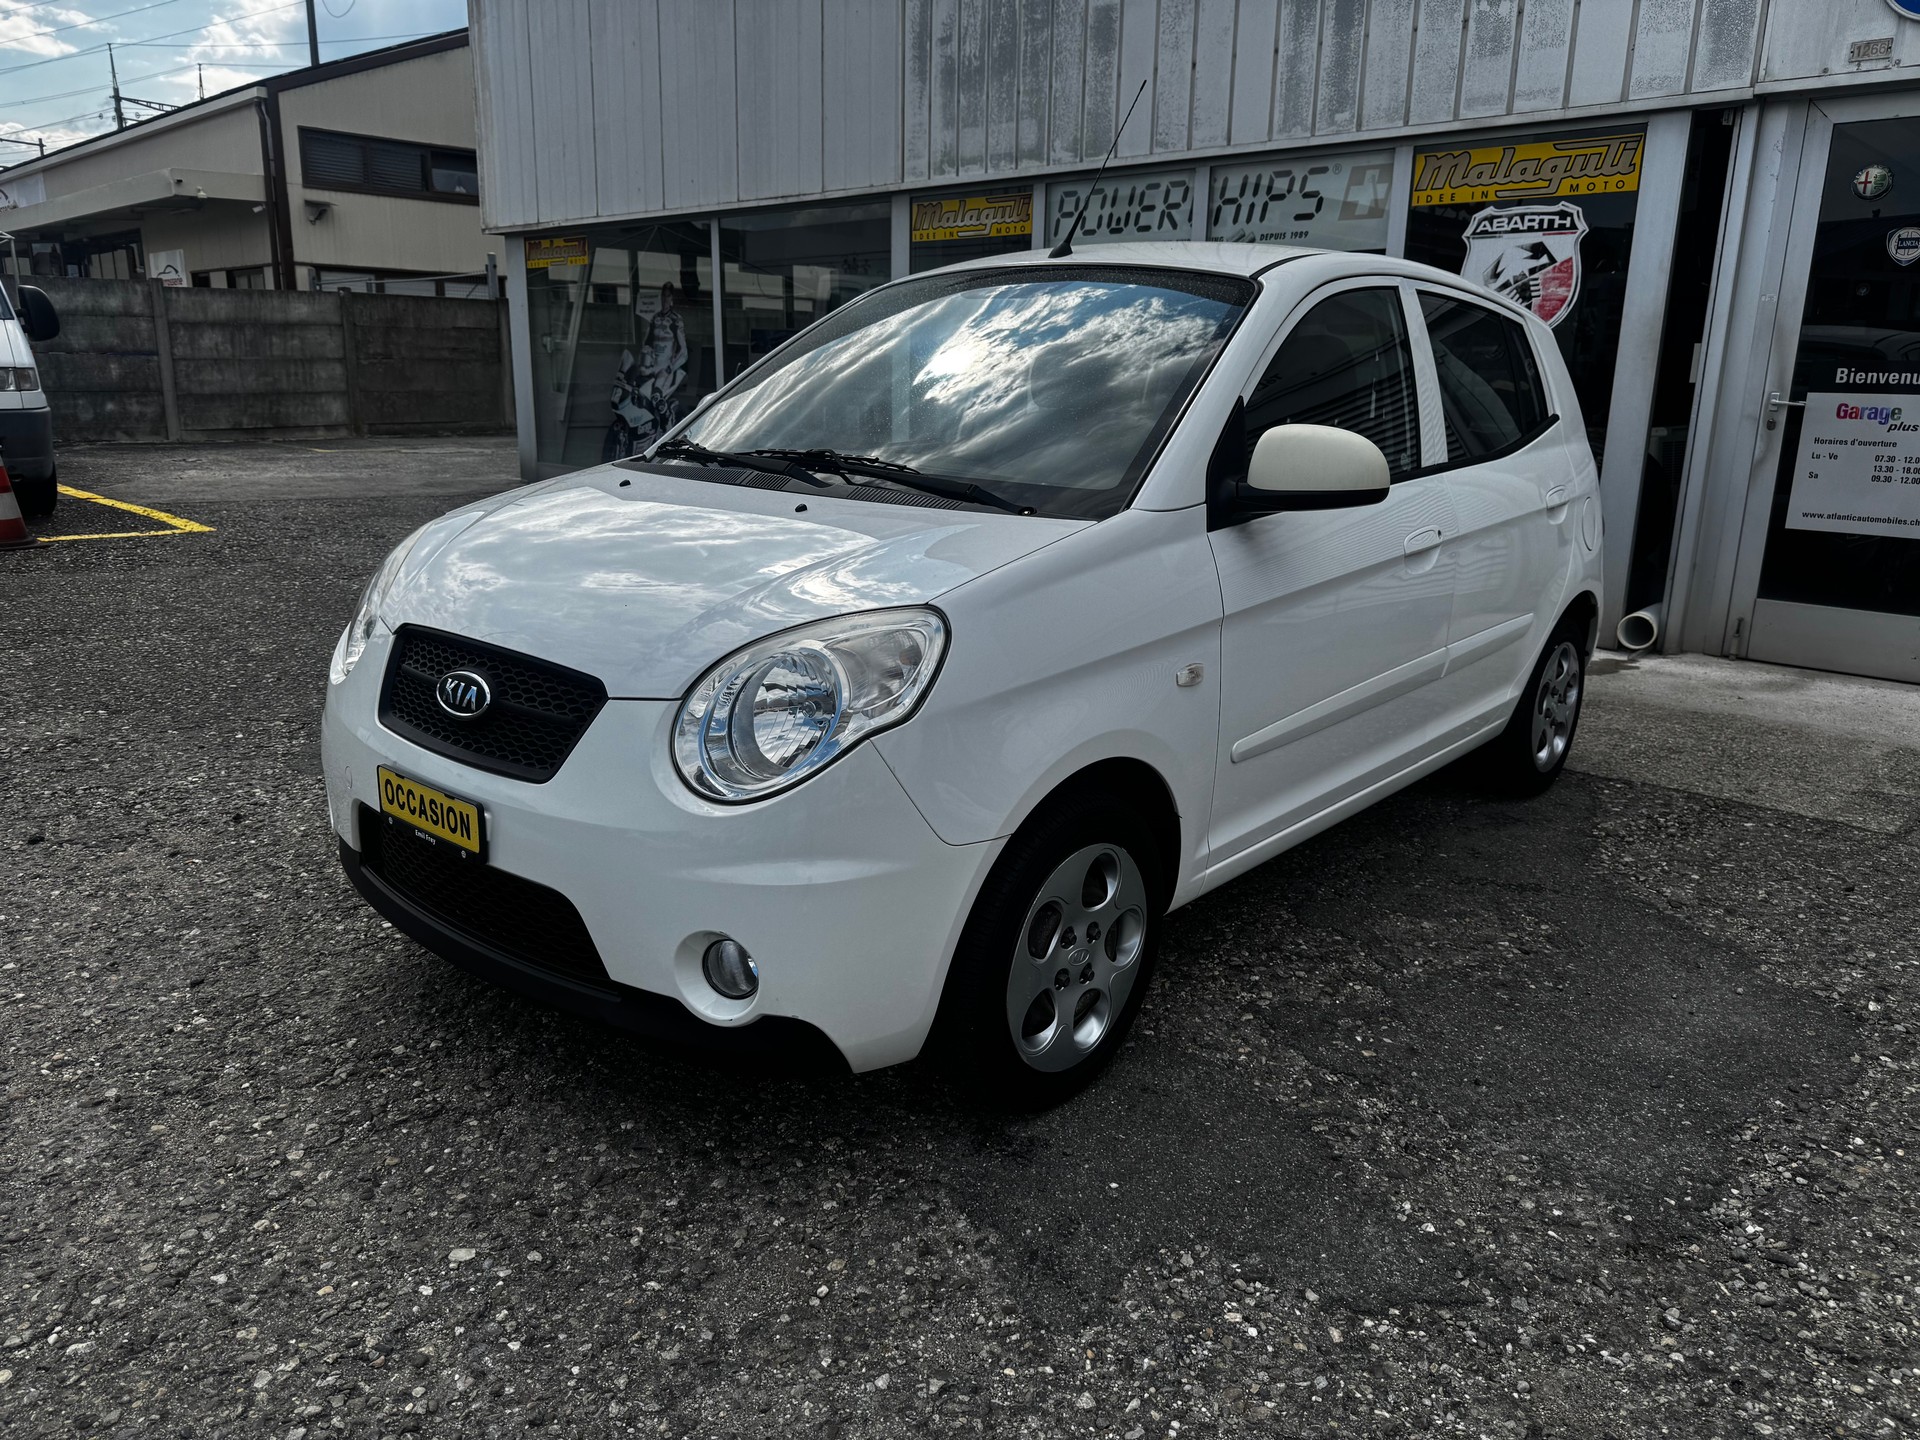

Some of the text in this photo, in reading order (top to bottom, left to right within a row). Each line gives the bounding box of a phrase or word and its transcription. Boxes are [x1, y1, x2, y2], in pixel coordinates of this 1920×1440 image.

[1855, 42, 1887, 58] 1266
[1414, 135, 1644, 199] Malaguti
[1213, 165, 1330, 227] HIPS
[1416, 180, 1625, 204] IDEE IN MOTO
[913, 194, 1032, 238] Malaguti
[1475, 215, 1571, 233] ABARTH
[914, 232, 936, 240] IDEE
[996, 226, 1026, 234] MOTO
[1259, 232, 1287, 241] DEPUIS
[1290, 230, 1309, 239] 1989
[1898, 240, 1920, 248] LANCIA
[1835, 368, 1920, 385] Bienvenu
[1836, 402, 1903, 425] Garage
[1886, 421, 1920, 432] plus
[1814, 437, 1898, 448] Horaires d'ouverture
[1811, 452, 1820, 460] Lu
[1904, 456, 1920, 464] 12.0
[1874, 465, 1894, 473] 13.30
[1871, 475, 1892, 483] 09.30
[1802, 512, 1920, 526] www.atlanticautomobiles.ch
[443, 678, 478, 710] KIA
[384, 778, 472, 841] OCCASION
